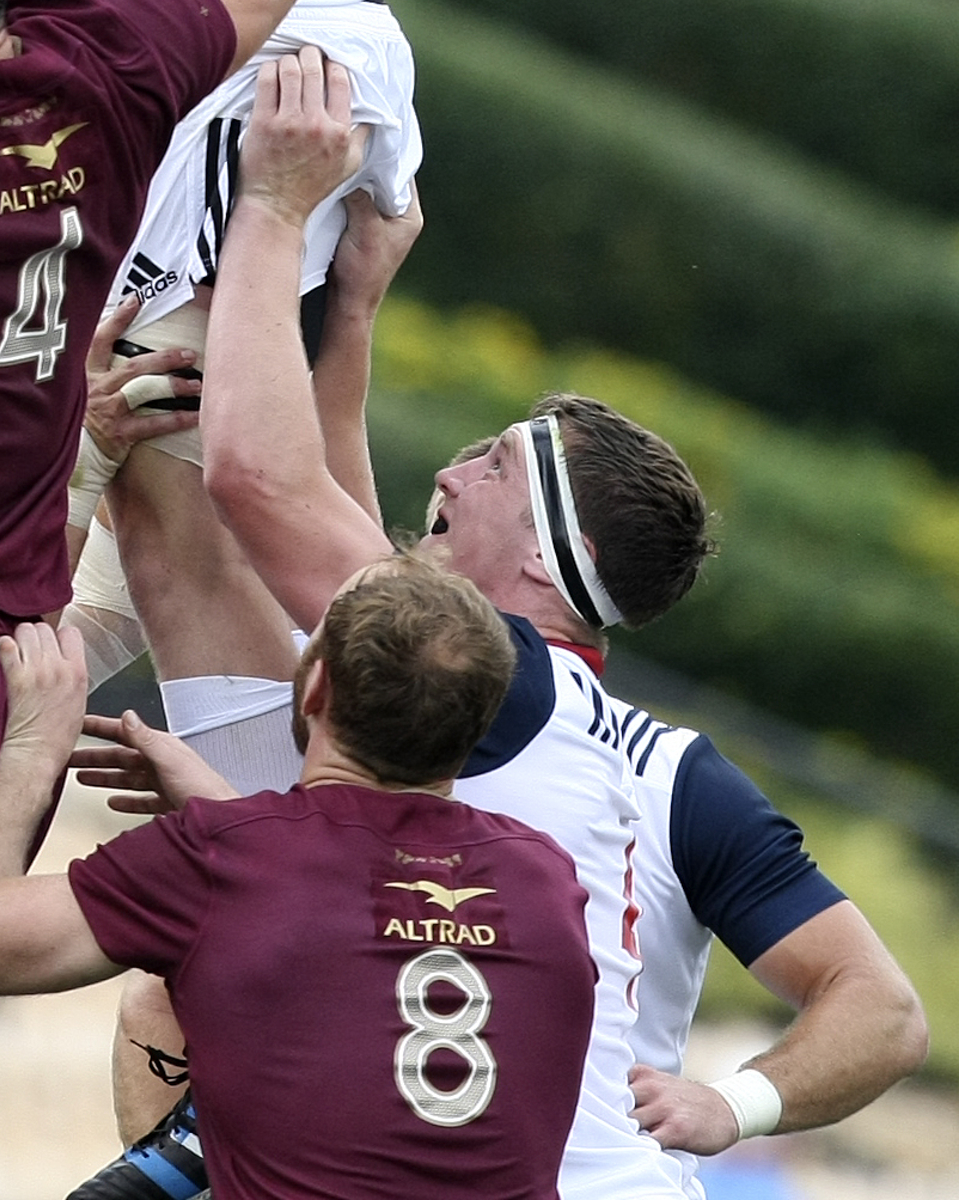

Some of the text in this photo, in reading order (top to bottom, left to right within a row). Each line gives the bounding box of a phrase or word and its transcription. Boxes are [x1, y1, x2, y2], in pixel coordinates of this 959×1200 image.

[118, 270, 179, 307] idas
[383, 917, 497, 947] ALTRAD
[394, 945, 497, 1128] 8
